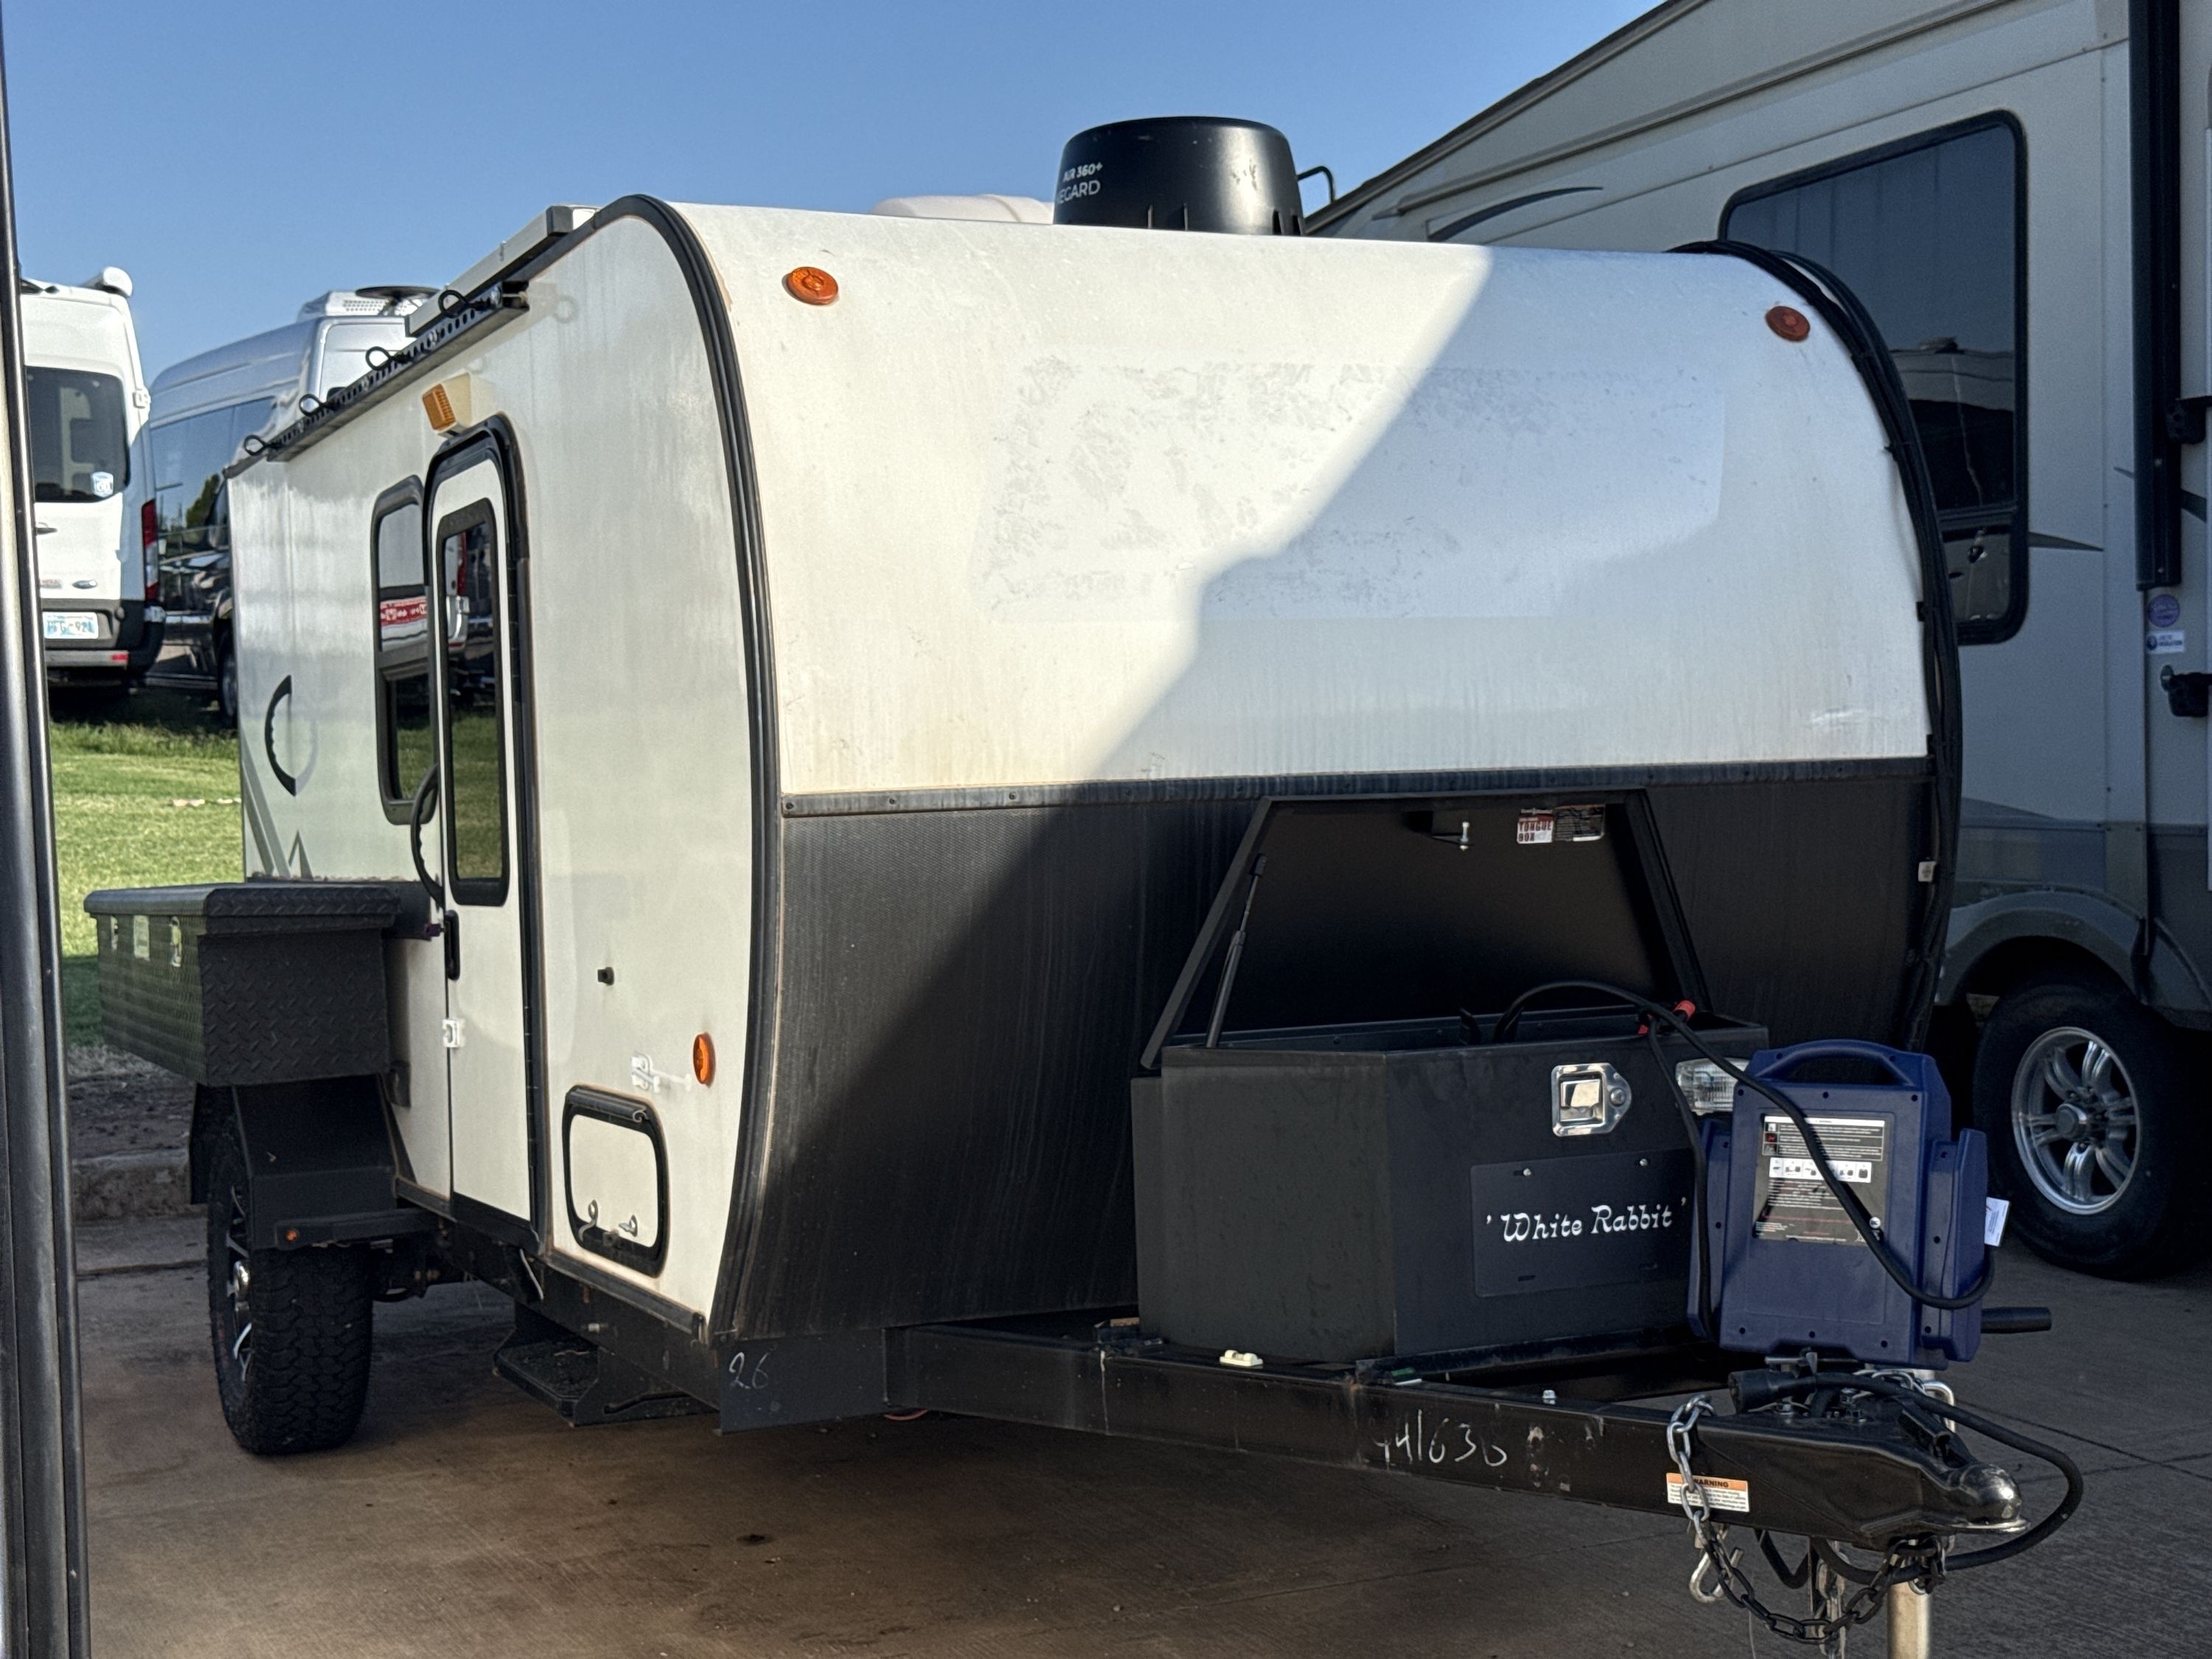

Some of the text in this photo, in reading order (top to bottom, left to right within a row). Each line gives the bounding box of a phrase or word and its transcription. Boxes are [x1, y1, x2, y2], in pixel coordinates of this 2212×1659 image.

[1076, 161, 1103, 178] 360+
[1518, 820, 1552, 832] TONGUE
[1518, 832, 1535, 842] BOX
[1500, 1211, 1583, 1243] White
[1590, 1203, 1673, 1235] Rabbit
[728, 1351, 771, 1390] 26
[1694, 1478, 1729, 1488] WARNING
